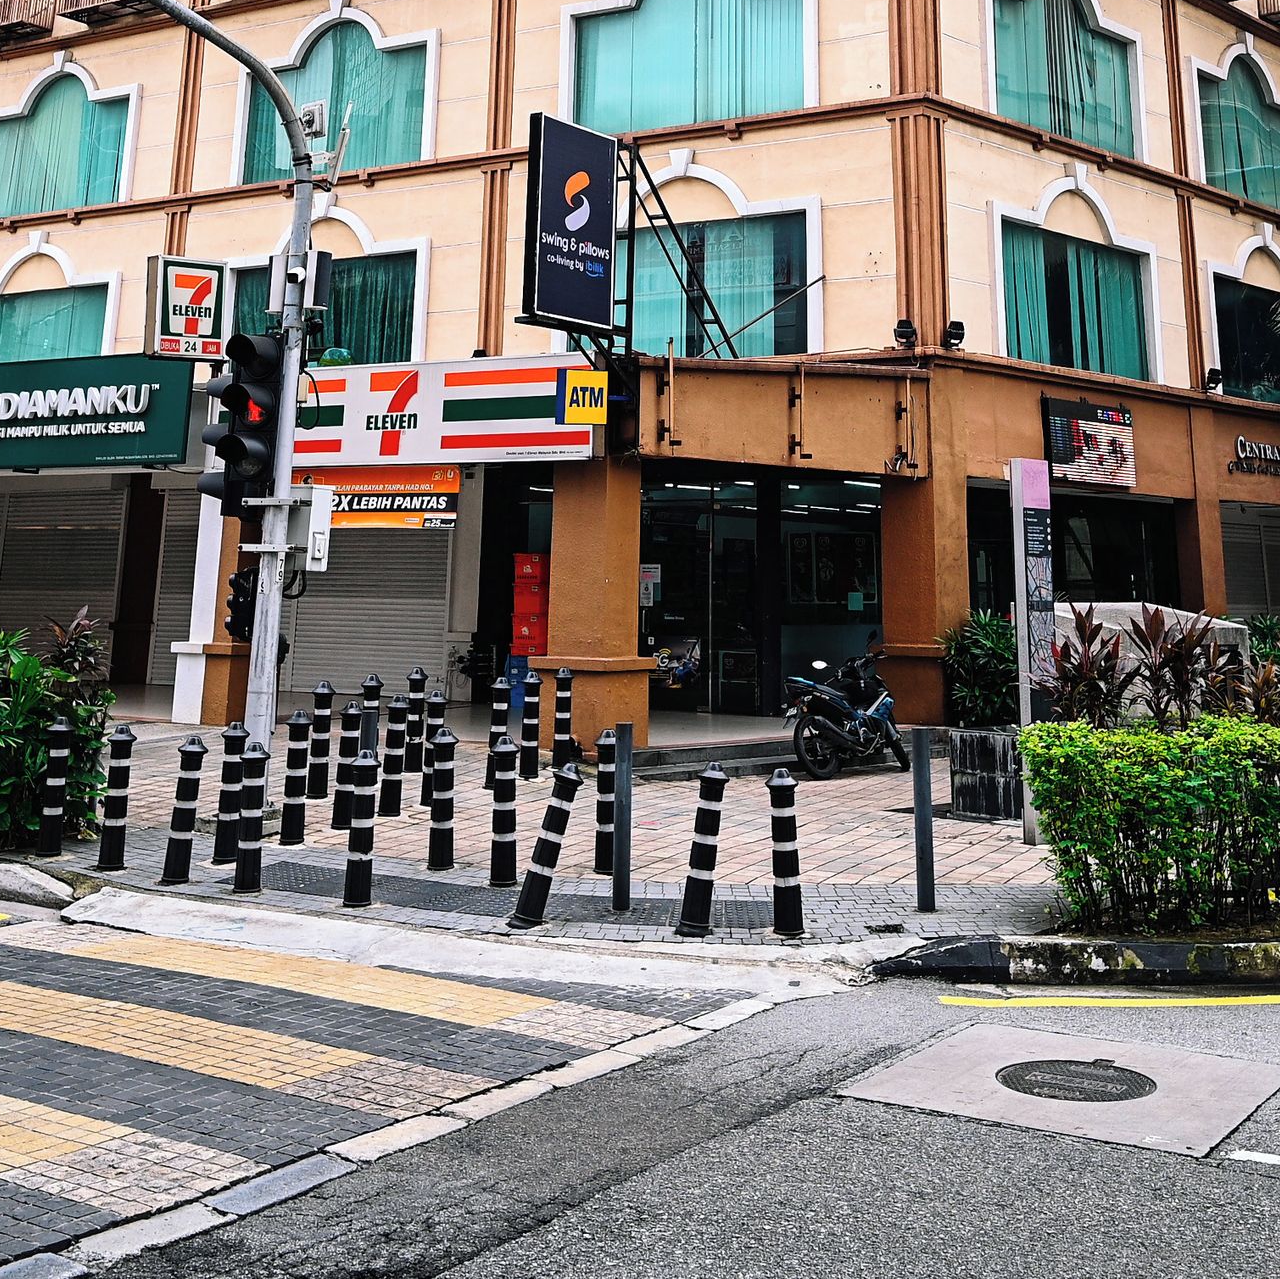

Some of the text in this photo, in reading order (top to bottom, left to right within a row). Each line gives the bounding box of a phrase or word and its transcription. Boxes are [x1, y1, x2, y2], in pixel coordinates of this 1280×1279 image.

[541, 231, 610, 260] swing & pillows
[546, 253, 574, 270] co-living
[575, 259, 584, 272] by
[174, 273, 213, 335] 7
[161, 340, 217, 352] DIBUKA 24 JAM
[568, 386, 604, 409] ATM
[369, 369, 419, 456] 7
[6, 425, 43, 439] MAMPU
[43, 423, 69, 437] MILIK
[70, 422, 107, 436] UNTUK
[107, 420, 146, 434] SEMUA
[384, 483, 405, 491] TANPA
[405, 483, 420, 491] HAD
[331, 495, 448, 512] 2X LEBIH PANTAS
[431, 519, 442, 528] 25
